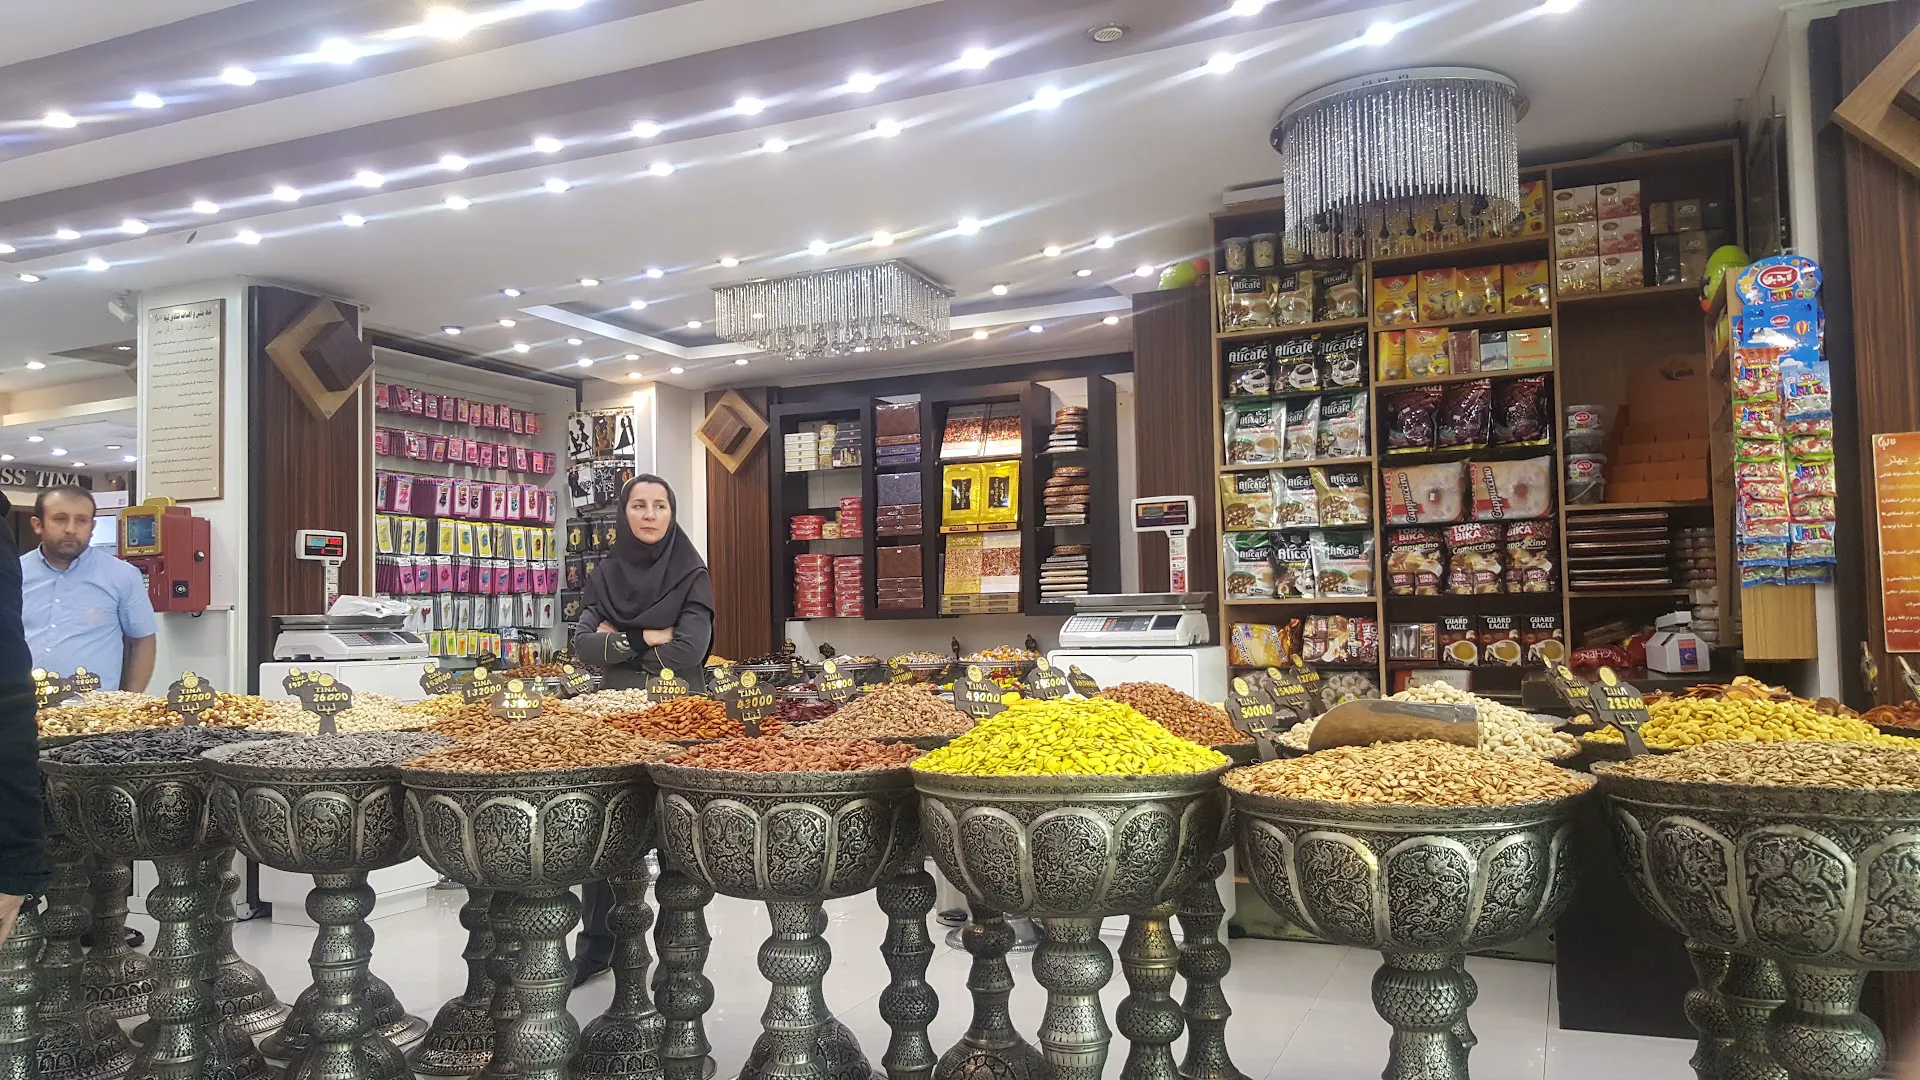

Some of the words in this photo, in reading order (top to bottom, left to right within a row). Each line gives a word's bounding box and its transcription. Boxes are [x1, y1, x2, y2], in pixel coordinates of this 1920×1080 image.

[0, 468, 26, 486] SS
[36, 471, 80, 488] TINA
[1399, 473, 1418, 523] Cappuccino
[1484, 467, 1504, 518] Cappuccino
[1452, 523, 1481, 534] TORA
[1454, 531, 1482, 542] BIKA
[824, 673, 843, 681] TINA
[473, 680, 492, 688] TINA
[820, 679, 853, 692] 295000
[965, 682, 989, 692] TINA
[467, 684, 502, 697] 132000
[652, 686, 686, 694] 132000
[738, 688, 762, 698] TINA
[1603, 687, 1628, 696] TINA
[178, 693, 211, 702] 27000
[313, 692, 348, 702] 26000
[737, 694, 772, 710] 43000
[966, 692, 1000, 703] 49000
[1238, 696, 1260, 706] TINA
[1241, 704, 1272, 719] 50000
